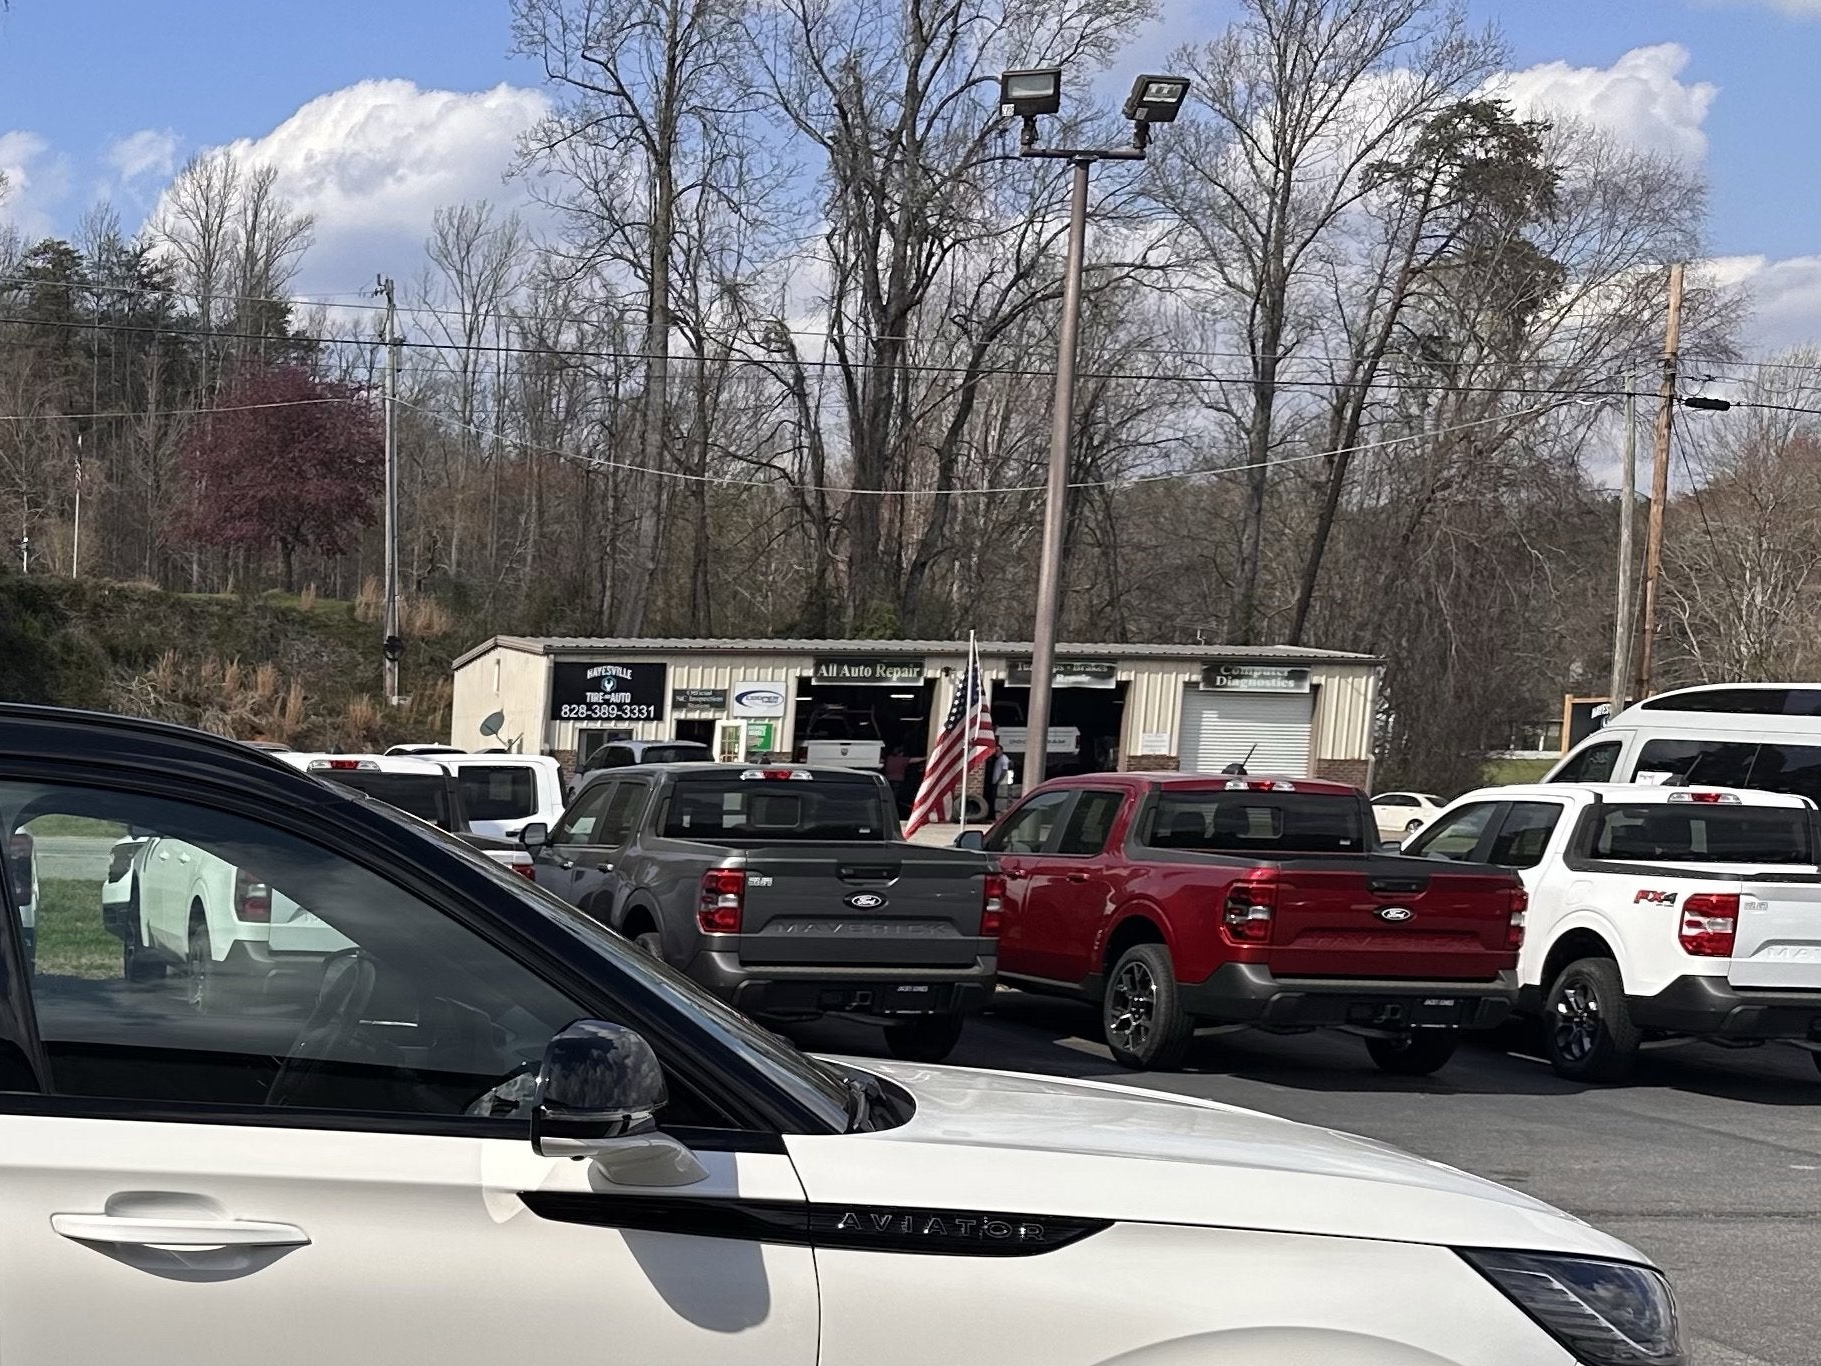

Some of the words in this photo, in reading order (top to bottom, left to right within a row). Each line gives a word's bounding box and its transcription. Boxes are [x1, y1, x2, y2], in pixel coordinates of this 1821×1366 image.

[587, 666, 632, 680] HAYESVILLE
[817, 664, 837, 677] All
[839, 664, 872, 677] Auto
[876, 664, 920, 681] Repair
[1215, 676, 1295, 688] Diagnostics
[586, 692, 604, 703] TIRE
[610, 692, 631, 703] AUTO
[561, 704, 655, 718] 828-389-3331
[1633, 890, 1678, 904] FX4
[778, 923, 947, 935] MAVERICK
[837, 1212, 1045, 1240] AVIATOR
